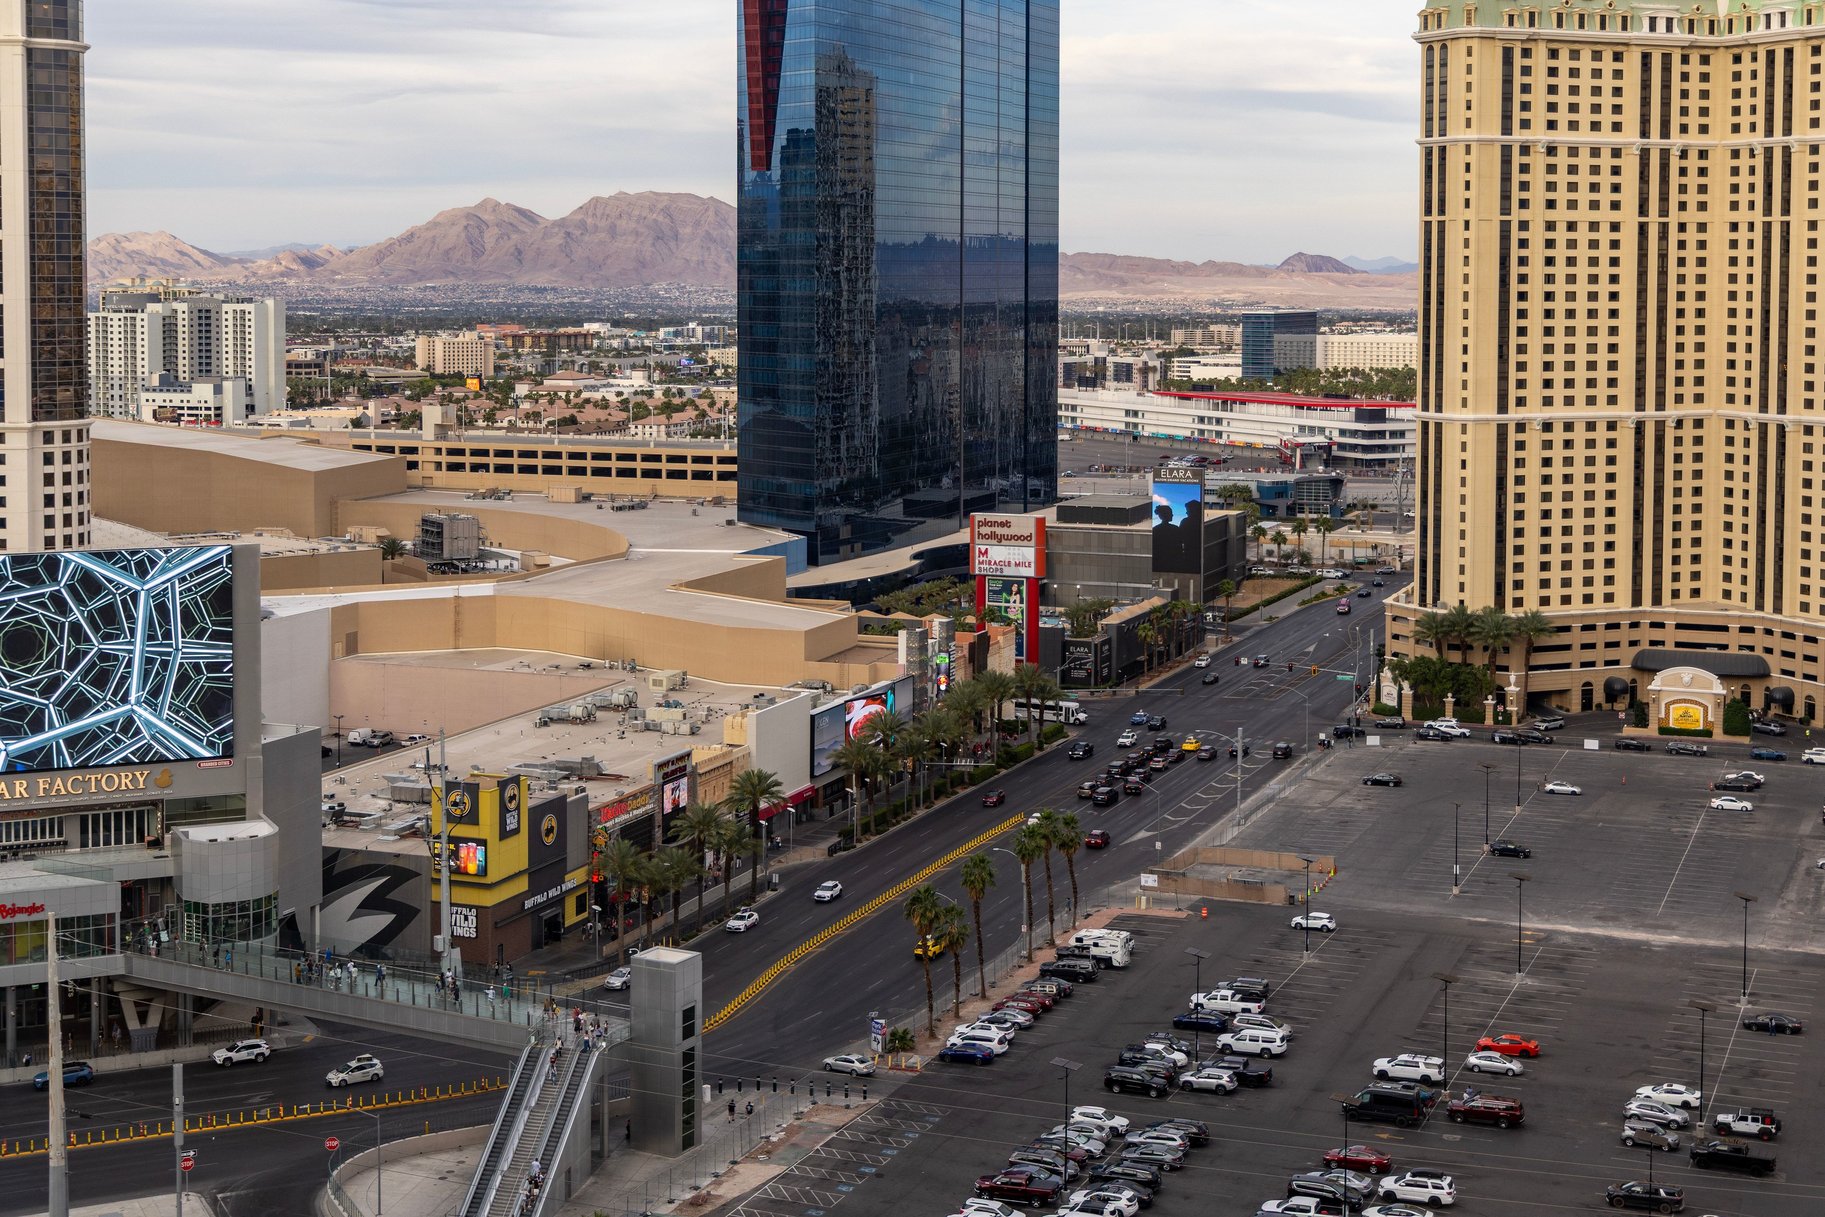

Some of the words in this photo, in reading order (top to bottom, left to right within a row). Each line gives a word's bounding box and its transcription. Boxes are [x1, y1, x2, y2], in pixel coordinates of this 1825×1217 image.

[1160, 469, 1193, 479] ELARA
[977, 517, 1012, 530] planet
[977, 530, 1033, 544] hollywood
[977, 546, 989, 559] M
[977, 558, 1012, 568] MIRACLE
[977, 566, 1004, 574] SHOPS
[36, 770, 151, 798] FACTORY
[627, 793, 651, 811] Daddy
[524, 890, 548, 910] BUFFALO
[548, 884, 561, 901] WILD
[561, 878, 577, 893] WINGS
[0, 902, 45, 919] Bojangles
[451, 907, 477, 916] FFALO
[452, 926, 477, 938] INGS
[180, 1160, 193, 1168] STOP
